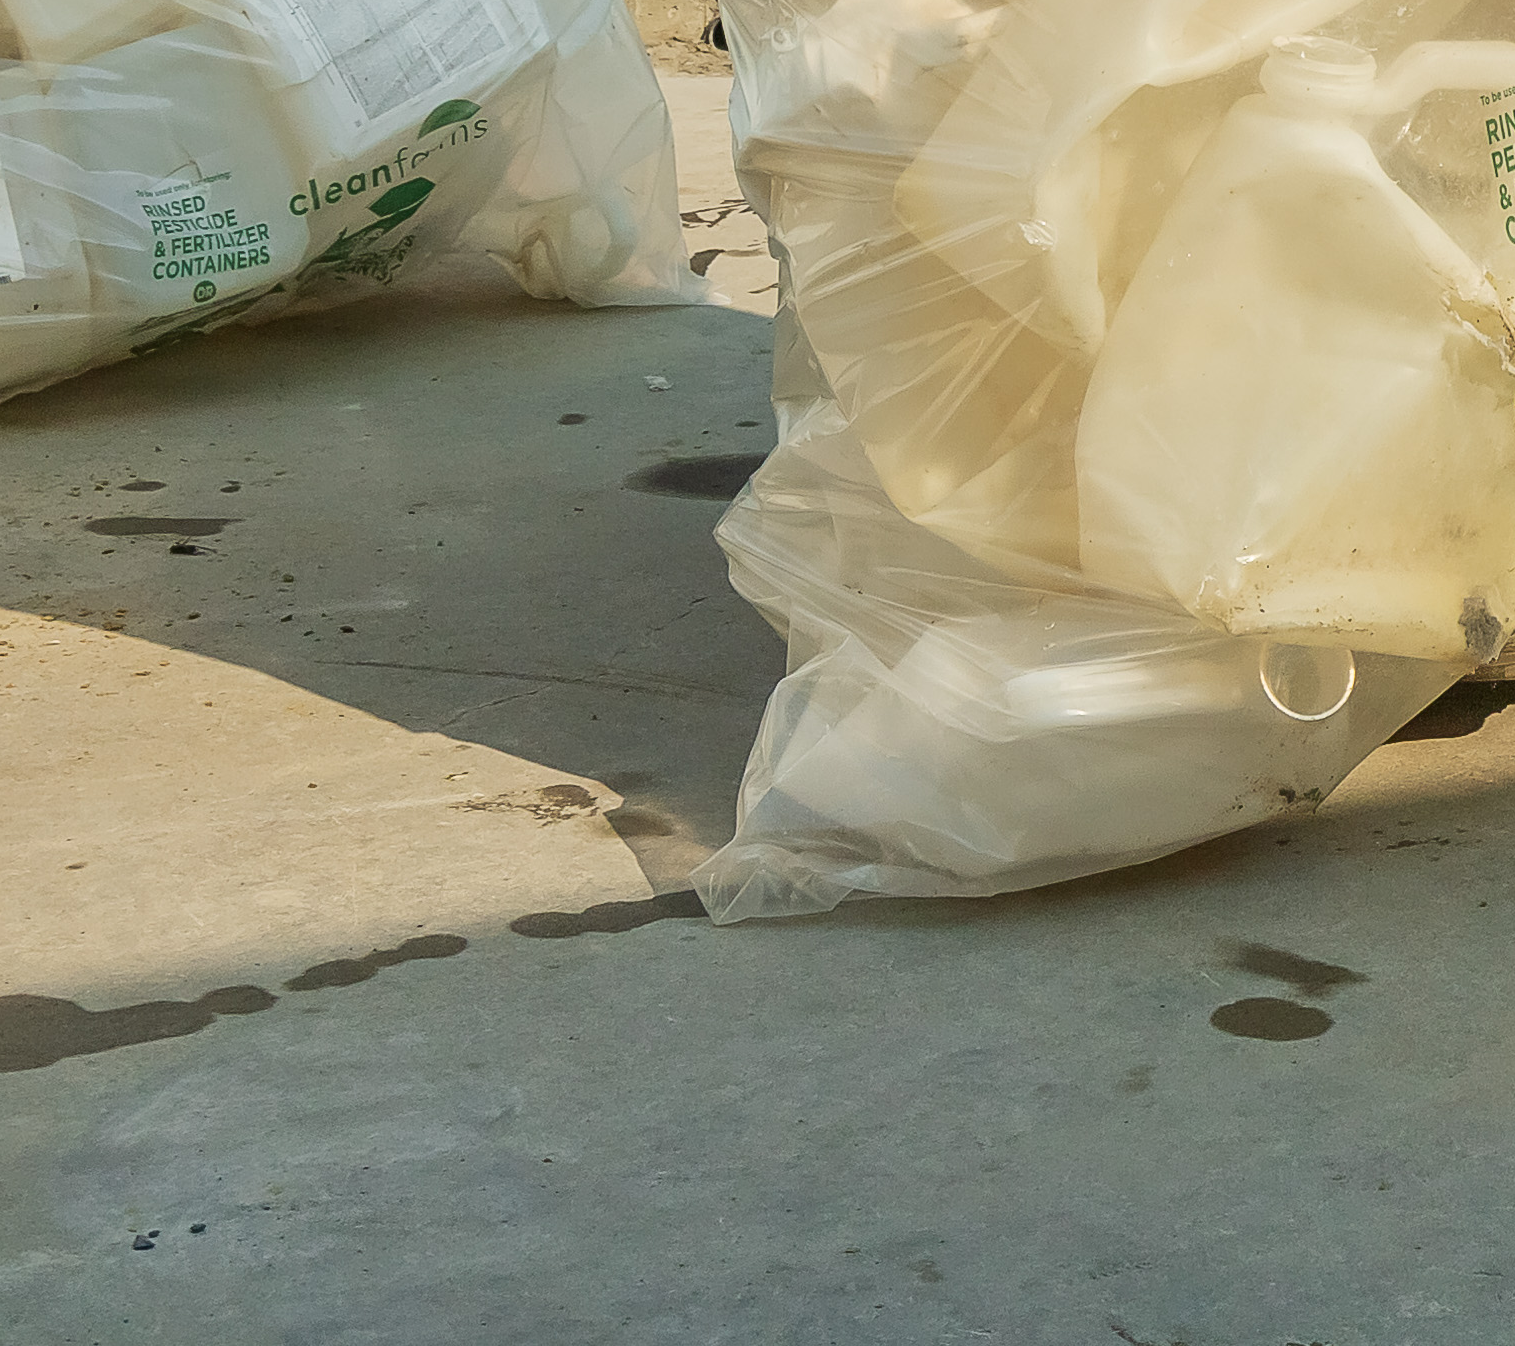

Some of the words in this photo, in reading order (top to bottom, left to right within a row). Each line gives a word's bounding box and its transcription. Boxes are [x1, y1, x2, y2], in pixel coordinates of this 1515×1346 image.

[1479, 94, 1491, 107] To
[1491, 90, 1502, 103] be
[141, 195, 206, 218] RINSED
[1499, 183, 1513, 210] &
[150, 208, 238, 236] PESTICIDE
[153, 240, 166, 258] &
[171, 222, 270, 257] FERTILIZER
[152, 245, 271, 280] CONTAINERS
